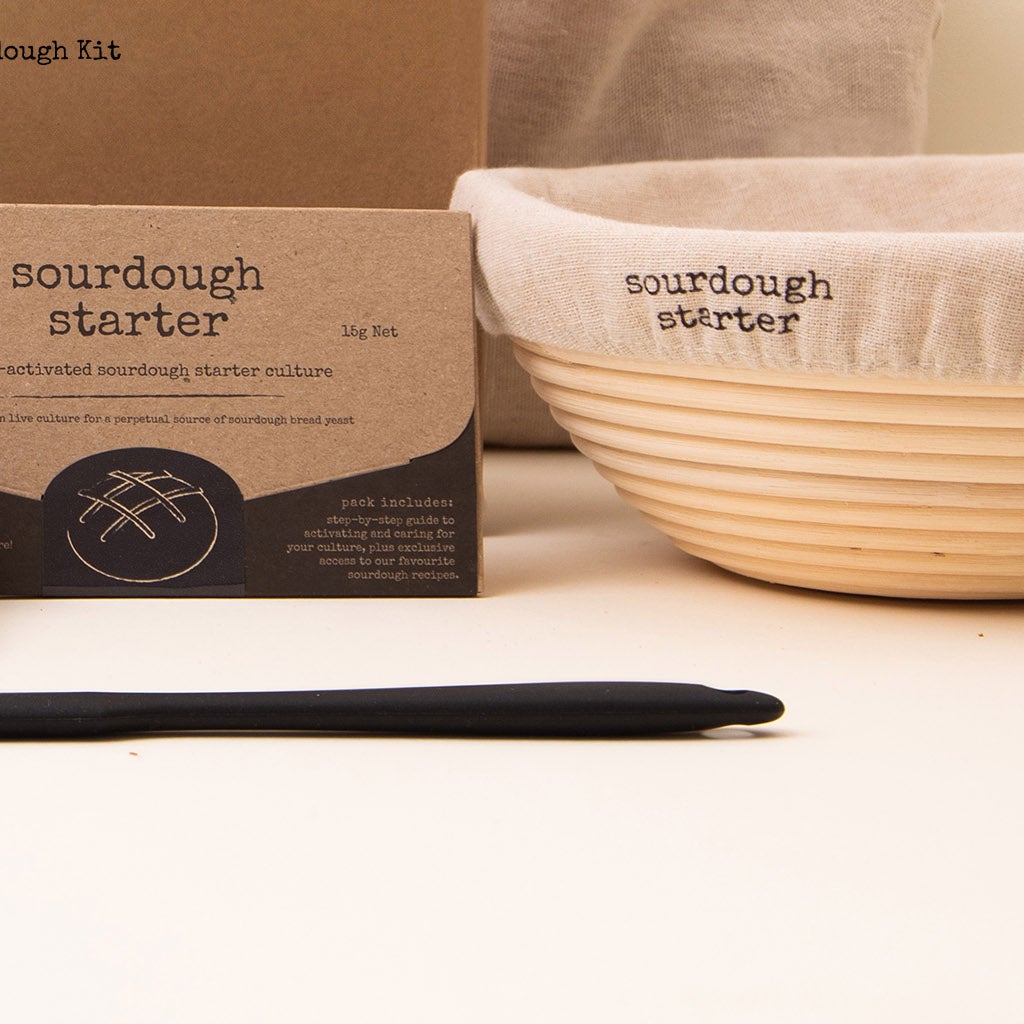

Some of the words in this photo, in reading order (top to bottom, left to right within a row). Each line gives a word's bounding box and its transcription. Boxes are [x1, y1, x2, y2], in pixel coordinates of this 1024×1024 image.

[77, 39, 121, 61] Kit
[11, 255, 264, 300] sourdough
[626, 265, 833, 305] sourdough
[48, 301, 229, 338] starter
[657, 304, 801, 335] starter
[341, 324, 368, 340] 15g
[372, 325, 398, 337] Net
[98, 362, 190, 379] sourdough
[194, 363, 260, 377] starter
[265, 363, 333, 378] culture
[9, 413, 34, 423] live
[36, 413, 80, 423] culture
[83, 414, 102, 423] for
[114, 414, 170, 426] perpetual
[173, 415, 211, 424] source
[213, 414, 227, 424] of
[228, 415, 287, 426] sourdough
[290, 415, 322, 425] bread
[324, 416, 355, 426] yeast
[341, 497, 375, 510] pack
[381, 497, 454, 508] includes:
[326, 515, 403, 527] step-by-step
[406, 515, 439, 527] guide
[442, 516, 455, 525] to
[304, 529, 368, 540] activating
[370, 529, 392, 538] and
[394, 529, 433, 540] caring
[436, 528, 455, 538] for
[286, 543, 314, 554] your
[317, 542, 366, 553] culture,
[369, 542, 395, 554] plus
[397, 542, 456, 552] exclusive
[319, 557, 356, 566] access
[359, 557, 372, 566] to
[374, 557, 396, 566] our
[398, 556, 456, 566] favourite
[347, 570, 408, 582] sourdough
[411, 570, 459, 582] recipes.
